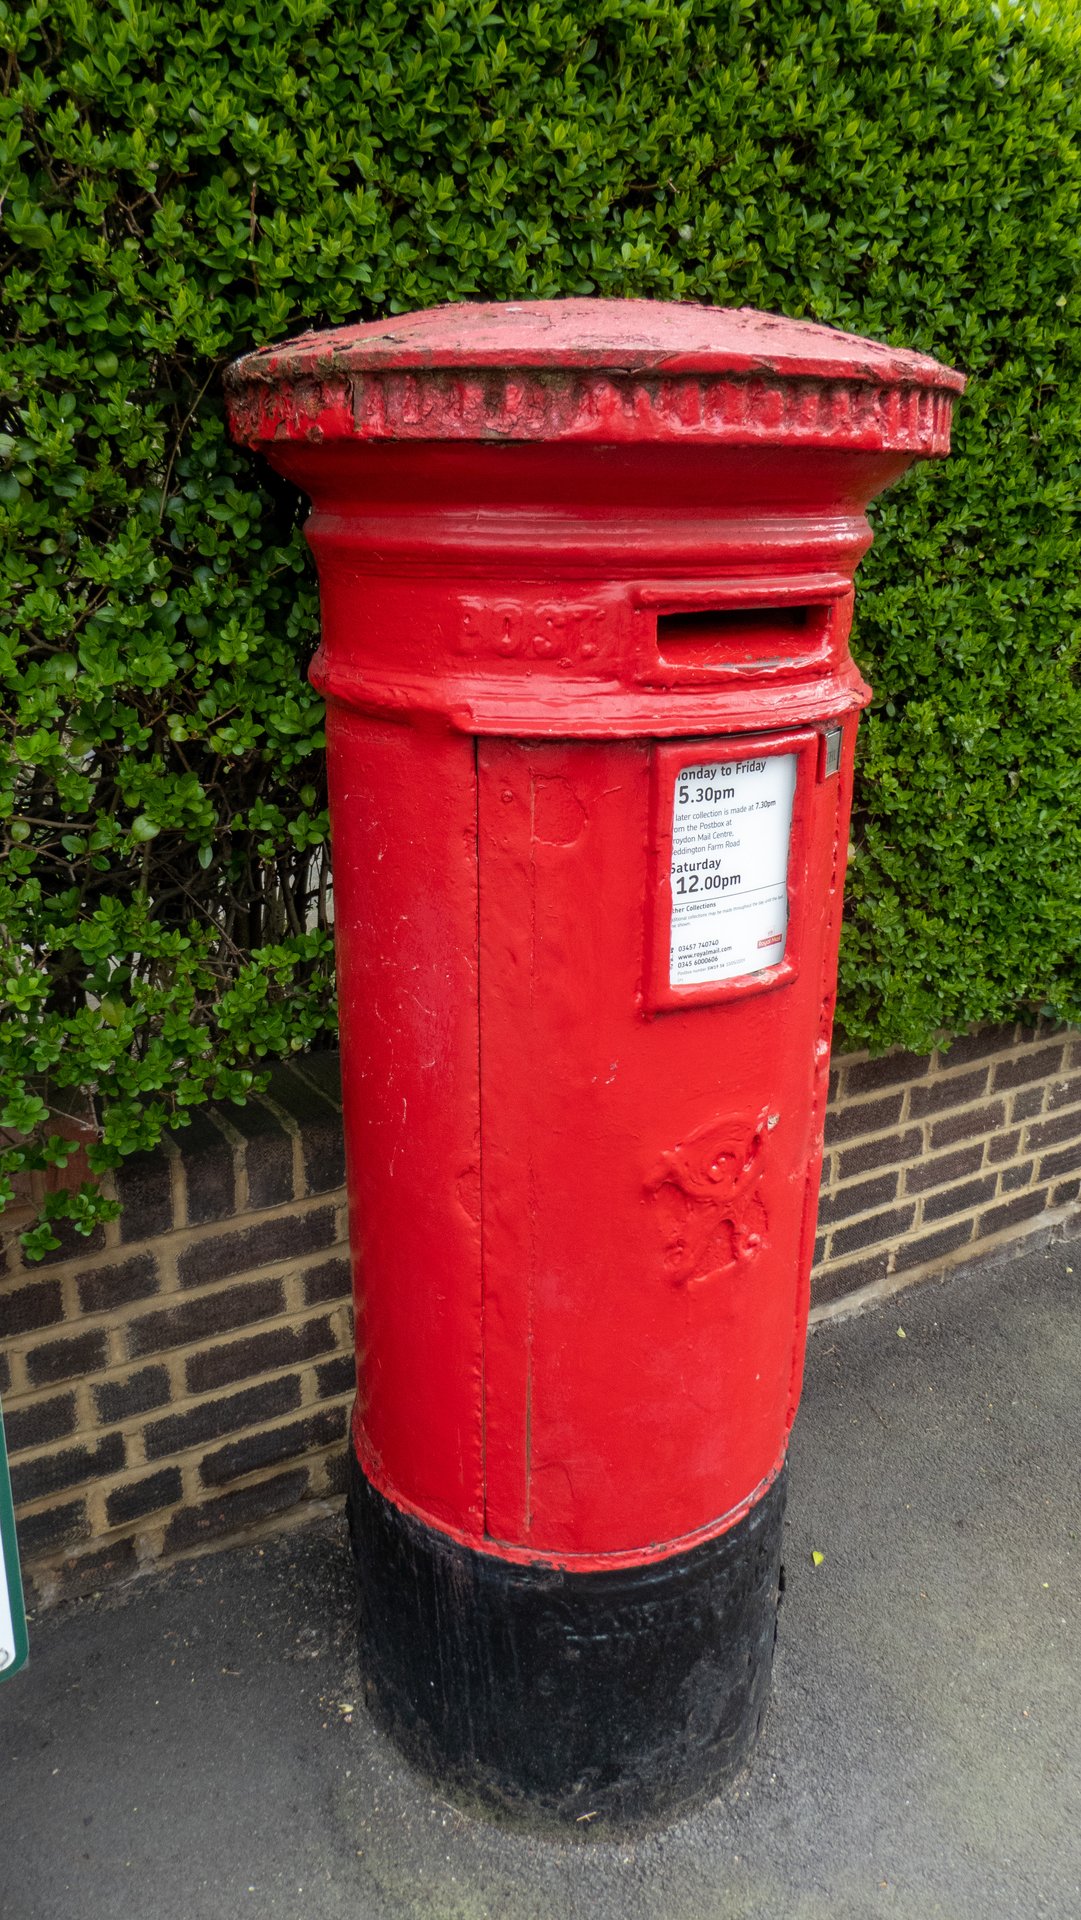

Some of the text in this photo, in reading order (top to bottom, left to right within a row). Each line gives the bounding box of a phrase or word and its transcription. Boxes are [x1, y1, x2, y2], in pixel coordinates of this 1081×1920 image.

[721, 766, 732, 776] to
[736, 761, 766, 774] Friday
[679, 785, 735, 804] 5.30pm
[693, 809, 722, 820] collection
[730, 806, 747, 814] made
[755, 800, 776, 811] 7.30pm
[687, 823, 698, 831] the
[700, 820, 724, 830] Postbox
[673, 830, 734, 845] roydon Mail Centre.
[672, 840, 741, 856] eddington Farm Road
[671, 859, 721, 874] Saturday
[676, 874, 741, 895] 12.00pm
[672, 902, 717, 914] ther Collections
[678, 939, 719, 952] 03457 740740
[678, 945, 732, 961] www.royalmail.com
[677, 960, 692, 969] 0345
